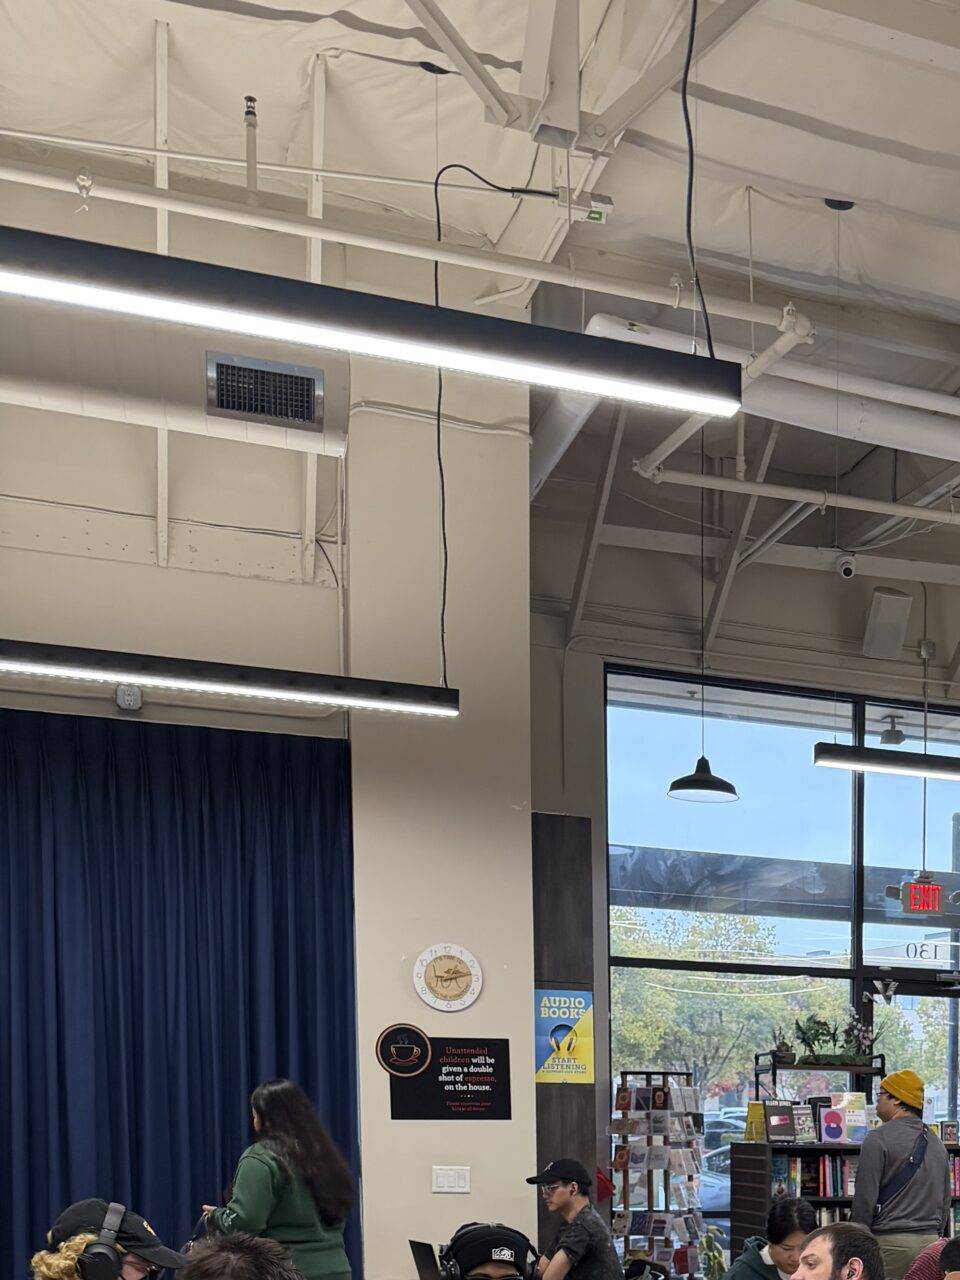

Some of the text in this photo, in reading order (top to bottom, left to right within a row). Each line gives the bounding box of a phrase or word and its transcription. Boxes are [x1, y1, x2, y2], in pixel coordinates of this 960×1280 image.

[910, 884, 941, 912] EXIT
[541, 997, 585, 1007] AUDIO
[541, 1008, 585, 1018] BOOKS
[446, 1047, 487, 1055] Unattended
[442, 1066, 462, 1074] given
